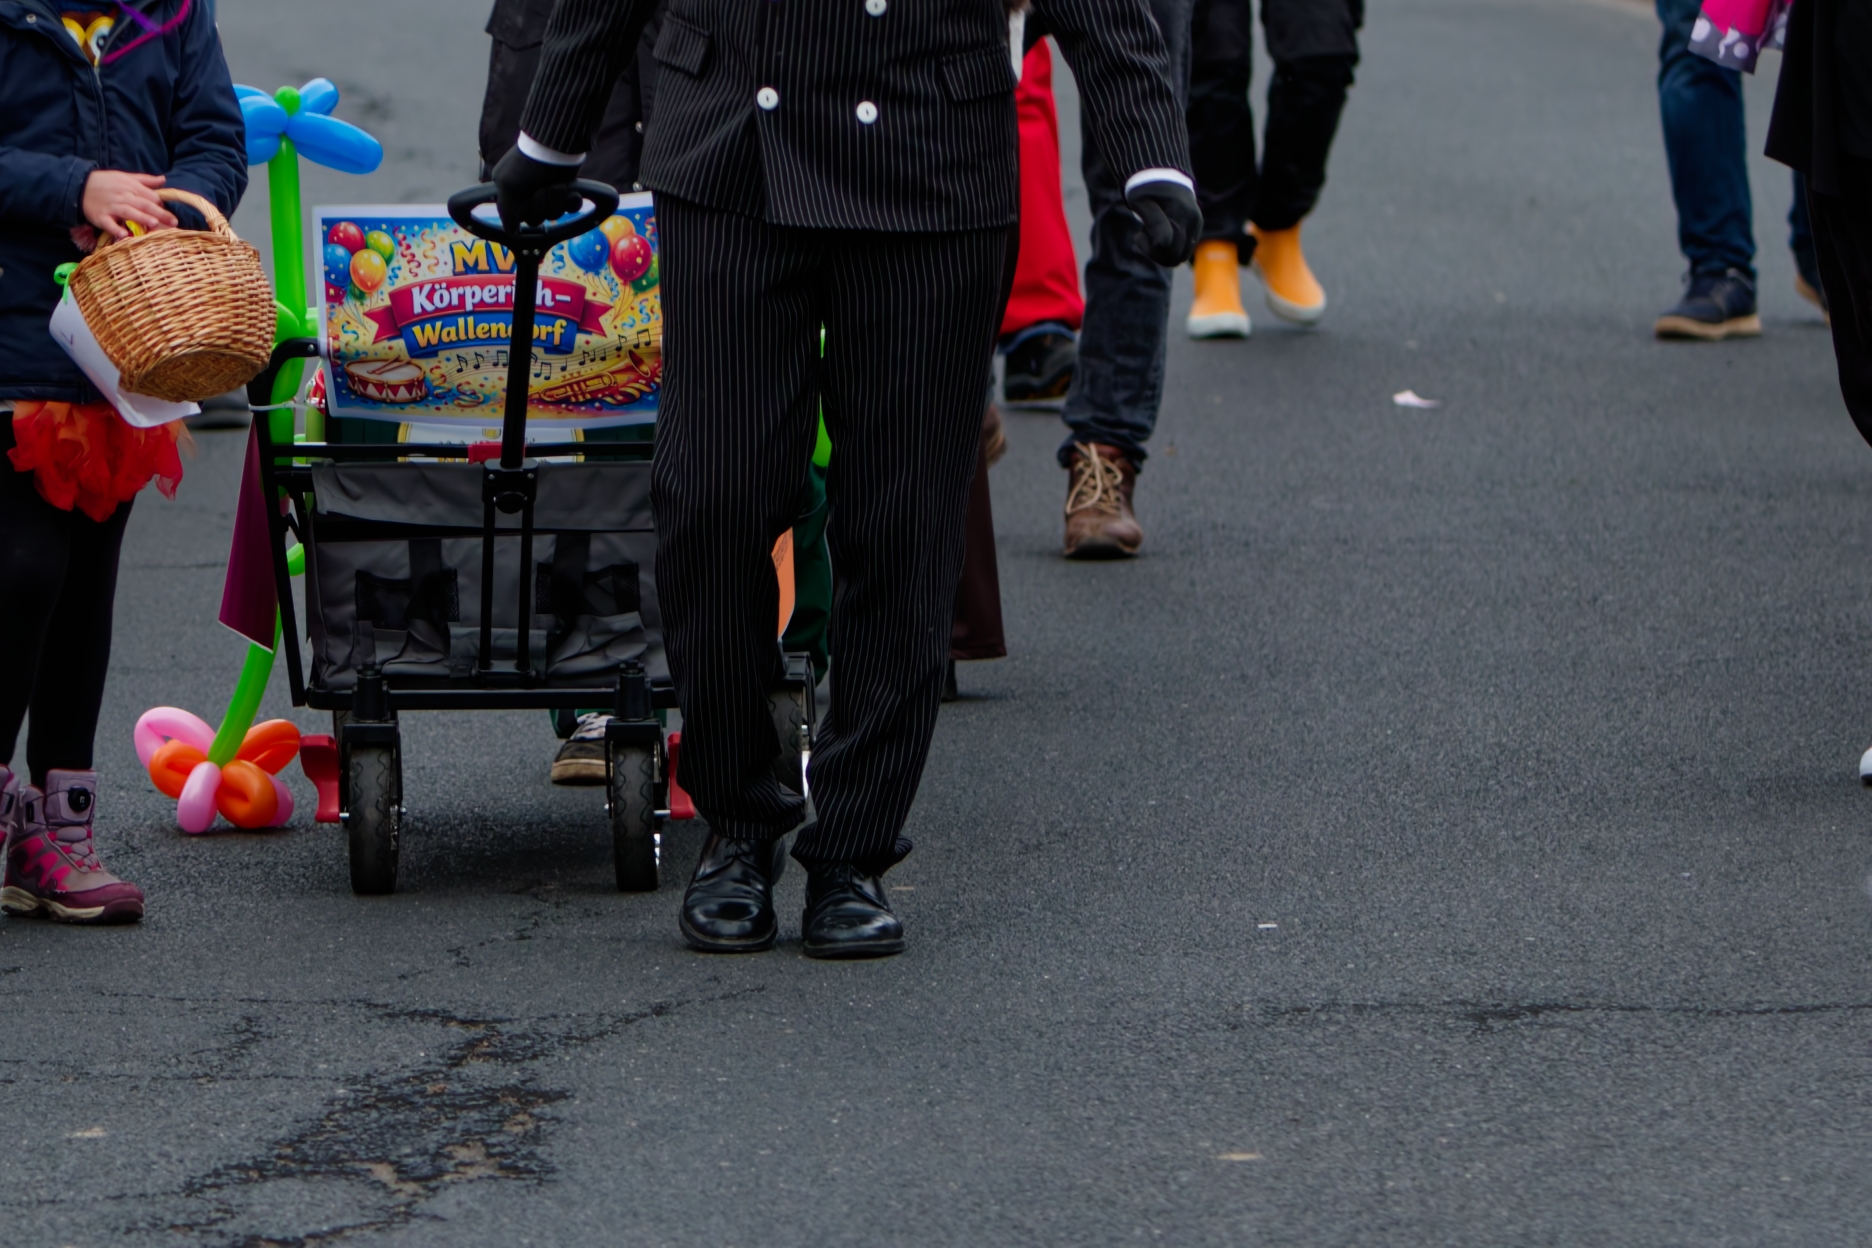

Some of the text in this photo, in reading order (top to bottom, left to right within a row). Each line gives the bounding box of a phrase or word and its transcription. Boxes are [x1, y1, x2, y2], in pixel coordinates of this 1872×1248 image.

[451, 239, 516, 274] MV
[411, 279, 571, 315] Körperih-
[412, 316, 567, 349] Wallenrf
